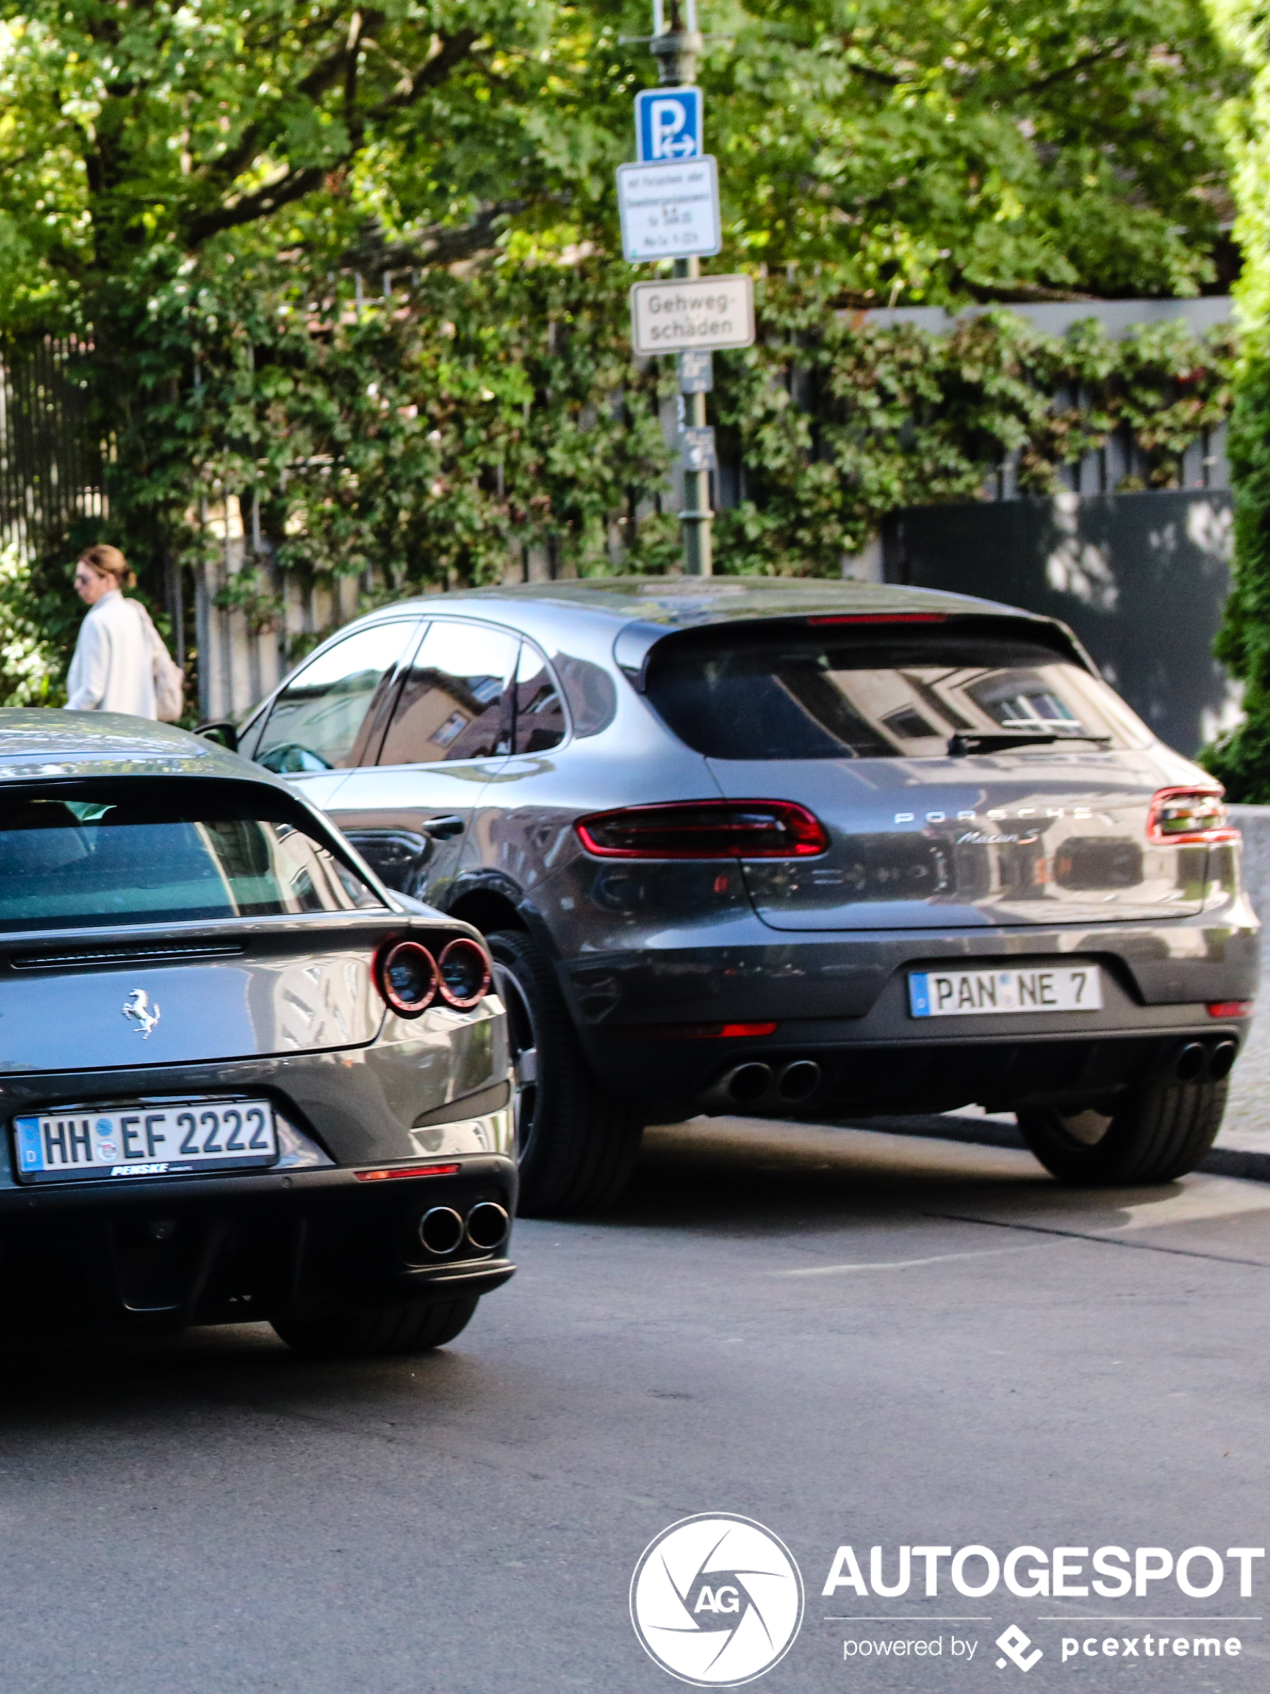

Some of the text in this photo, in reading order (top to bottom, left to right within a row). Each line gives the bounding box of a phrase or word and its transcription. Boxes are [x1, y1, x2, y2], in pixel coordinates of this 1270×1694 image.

[652, 99, 685, 158] P
[649, 294, 734, 314] Gehweg-
[650, 318, 733, 340] schäden
[894, 807, 1092, 824] PORSCHE
[956, 827, 1041, 845] Macan S
[934, 976, 997, 1010] PAN
[1017, 974, 1057, 1006] NE
[1071, 972, 1087, 1003] 7
[43, 1120, 93, 1164] HH
[120, 1114, 166, 1159] EF
[177, 1108, 268, 1154] 2222
[110, 1163, 169, 1176] PENSKE
